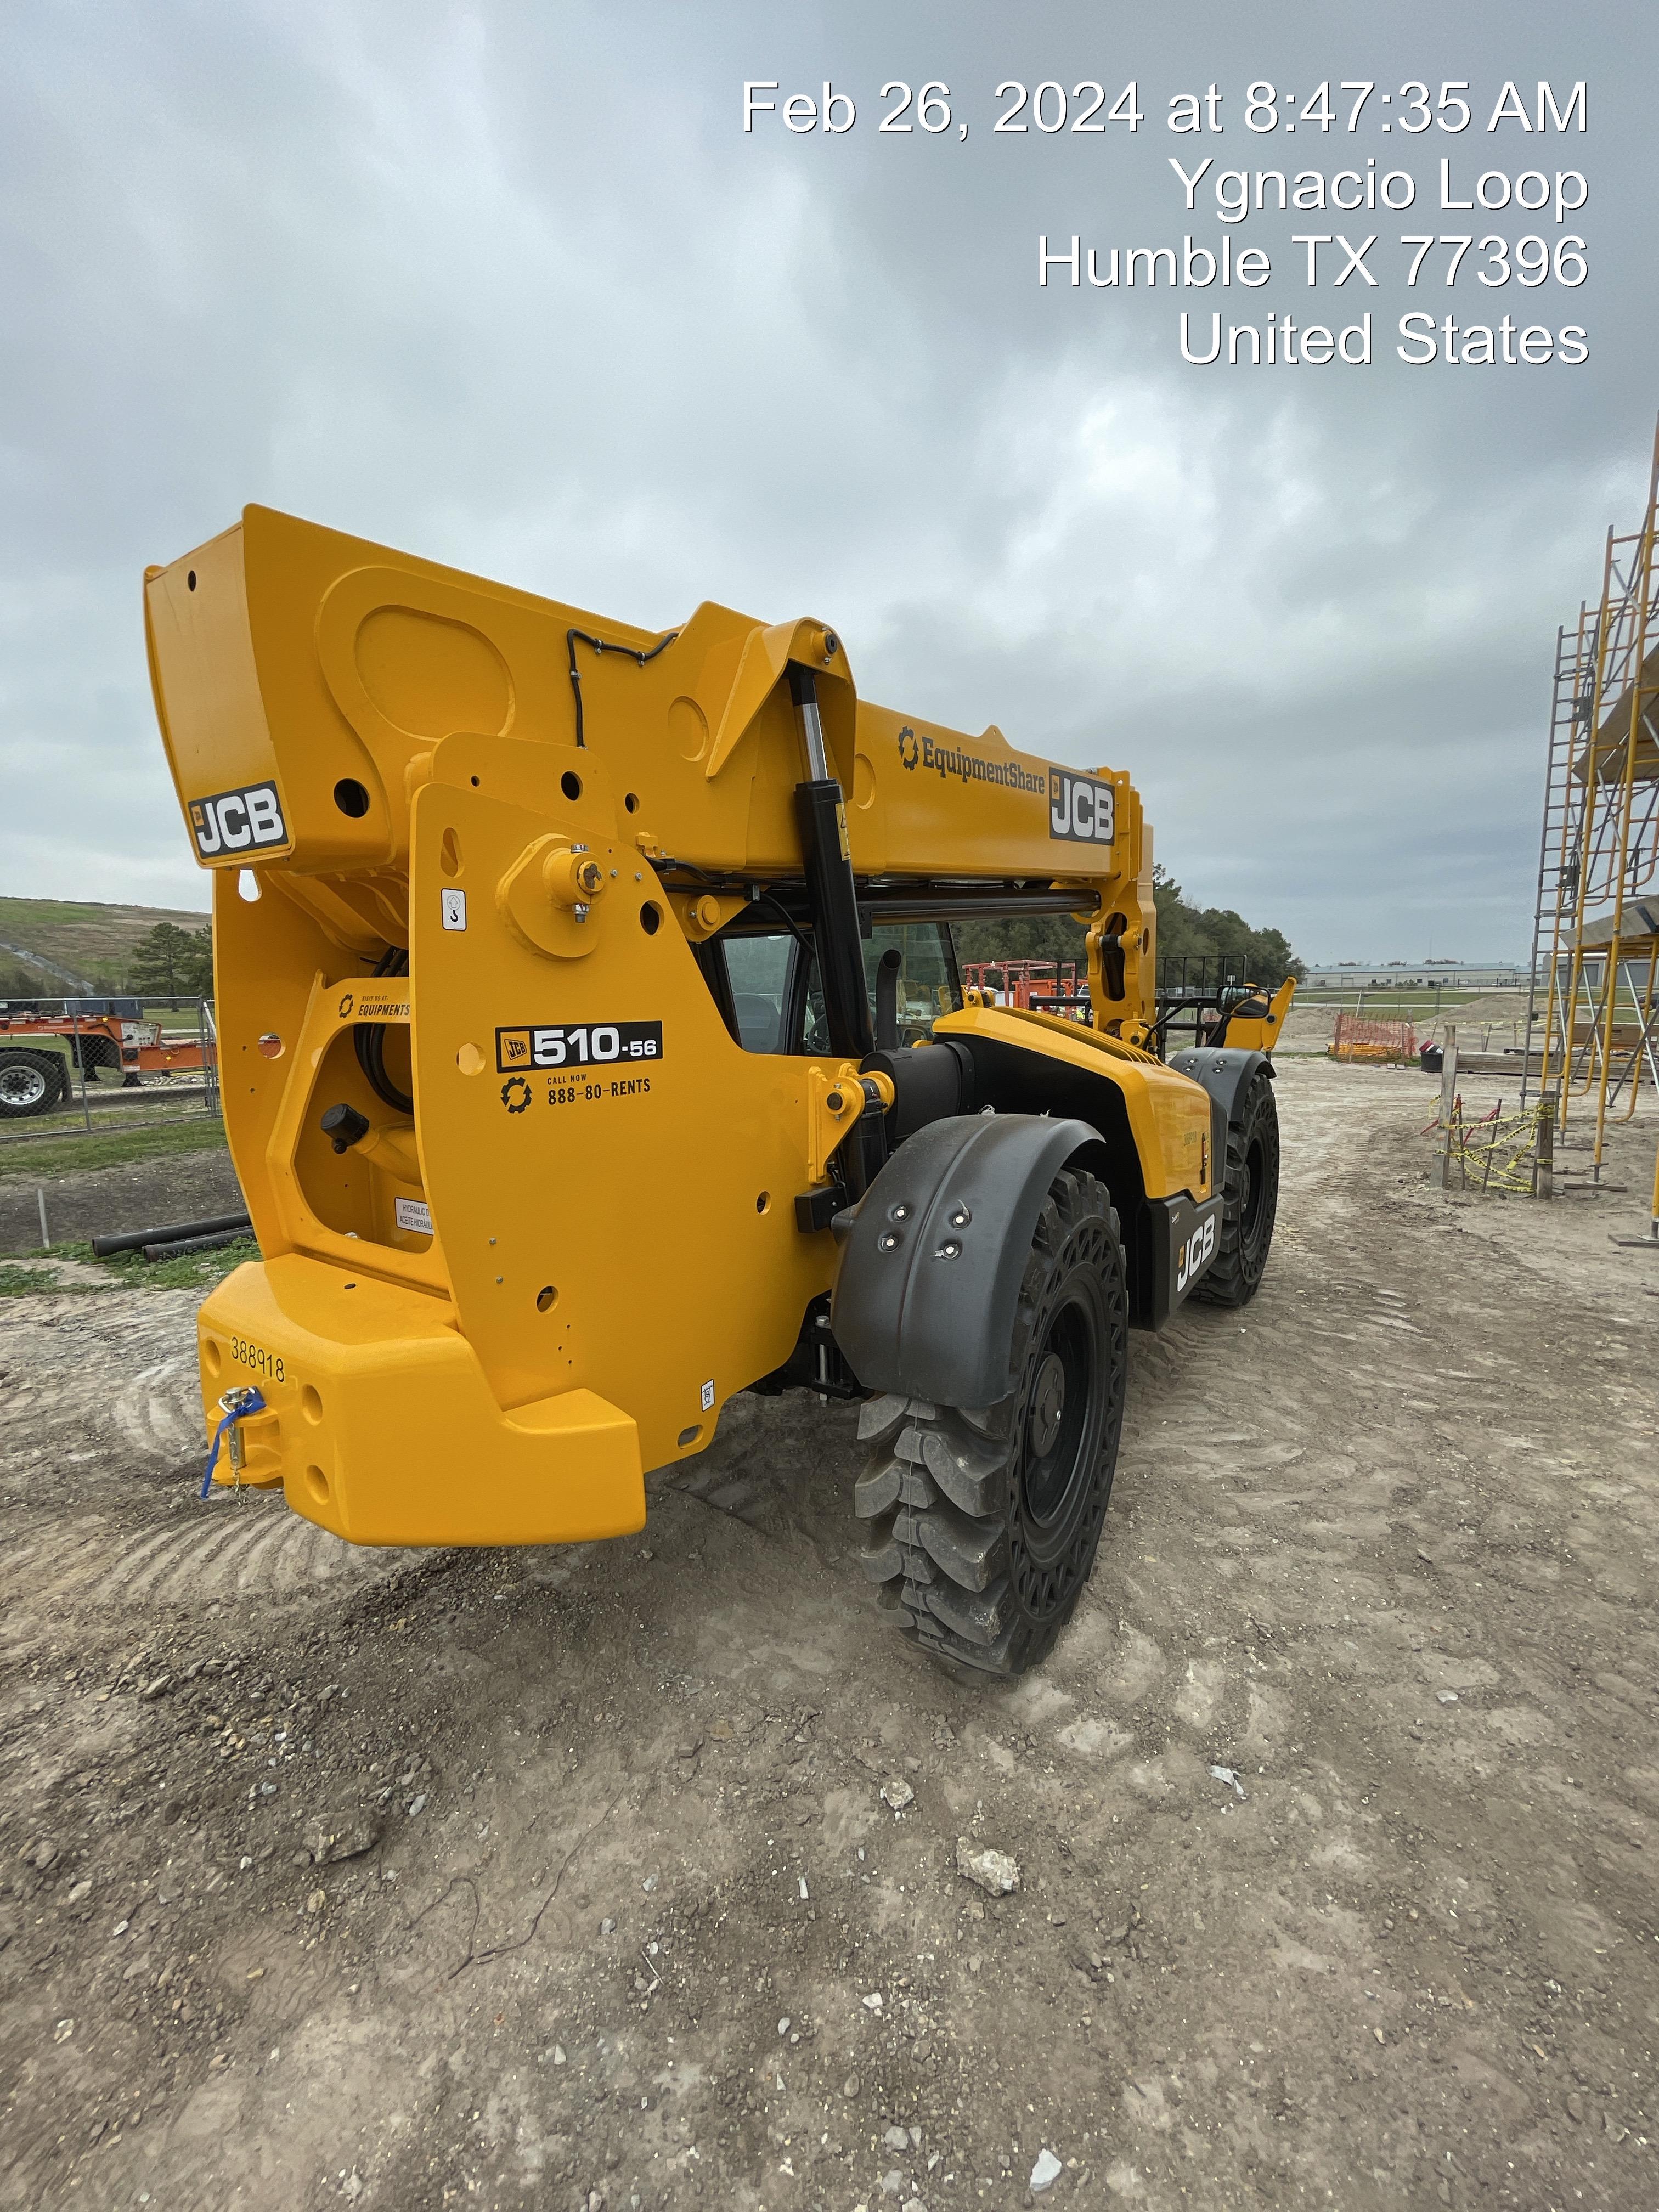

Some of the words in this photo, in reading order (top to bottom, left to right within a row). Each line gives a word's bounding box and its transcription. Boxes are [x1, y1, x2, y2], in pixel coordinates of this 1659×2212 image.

[921, 736, 1045, 795] EquipmentShare
[197, 788, 284, 853] JCB
[1051, 777, 1114, 840] JCB
[358, 1004, 410, 1017] EQUIPMENTS
[508, 1041, 526, 1058] JCB
[533, 1026, 657, 1065] 510-56
[547, 1076, 567, 1085] CALL
[570, 1074, 587, 1083] NOW
[548, 1077, 651, 1105] 888-80-RENTS
[399, 1215, 414, 1226] ACEITE
[402, 1204, 426, 1216] HYDRAULIC
[1177, 1213, 1216, 1293] JCB
[231, 1336, 285, 1383] 388918
